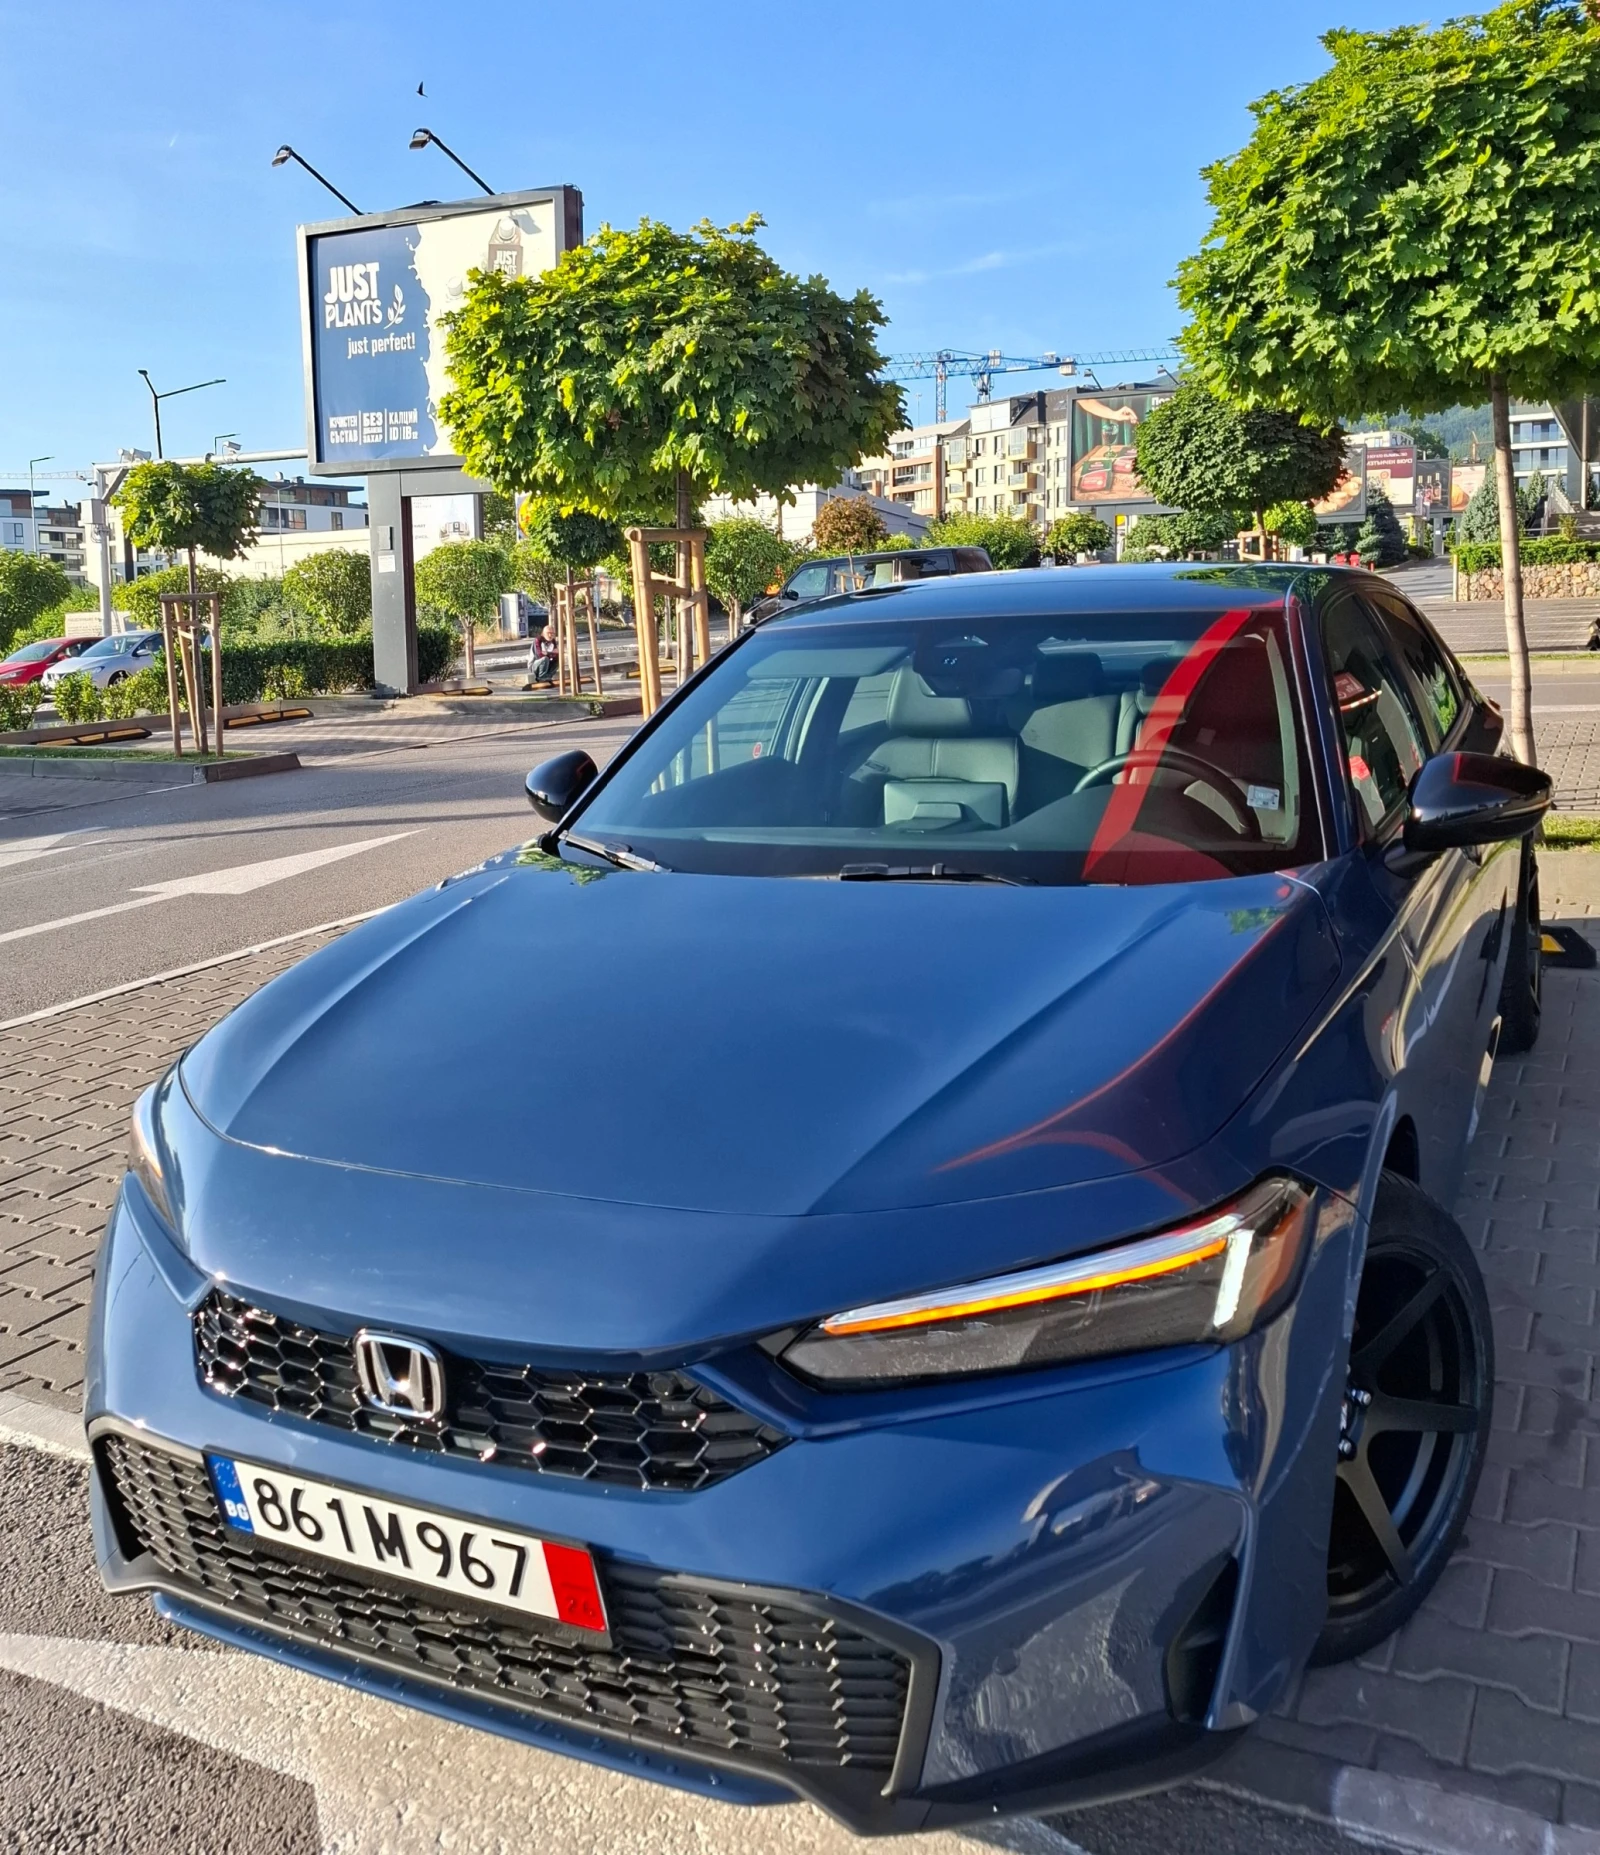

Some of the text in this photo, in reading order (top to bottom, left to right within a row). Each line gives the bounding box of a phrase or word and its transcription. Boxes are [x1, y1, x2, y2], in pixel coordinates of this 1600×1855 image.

[494, 250, 517, 265] JUST
[324, 262, 380, 304] JUST
[325, 299, 383, 329] PLANTS
[347, 332, 416, 359] just perfect!
[363, 412, 383, 427] БЕЗ
[388, 408, 418, 426] КАЛЦИЙ
[330, 430, 358, 444] СЪСТАВ
[224, 1499, 250, 1521] BG
